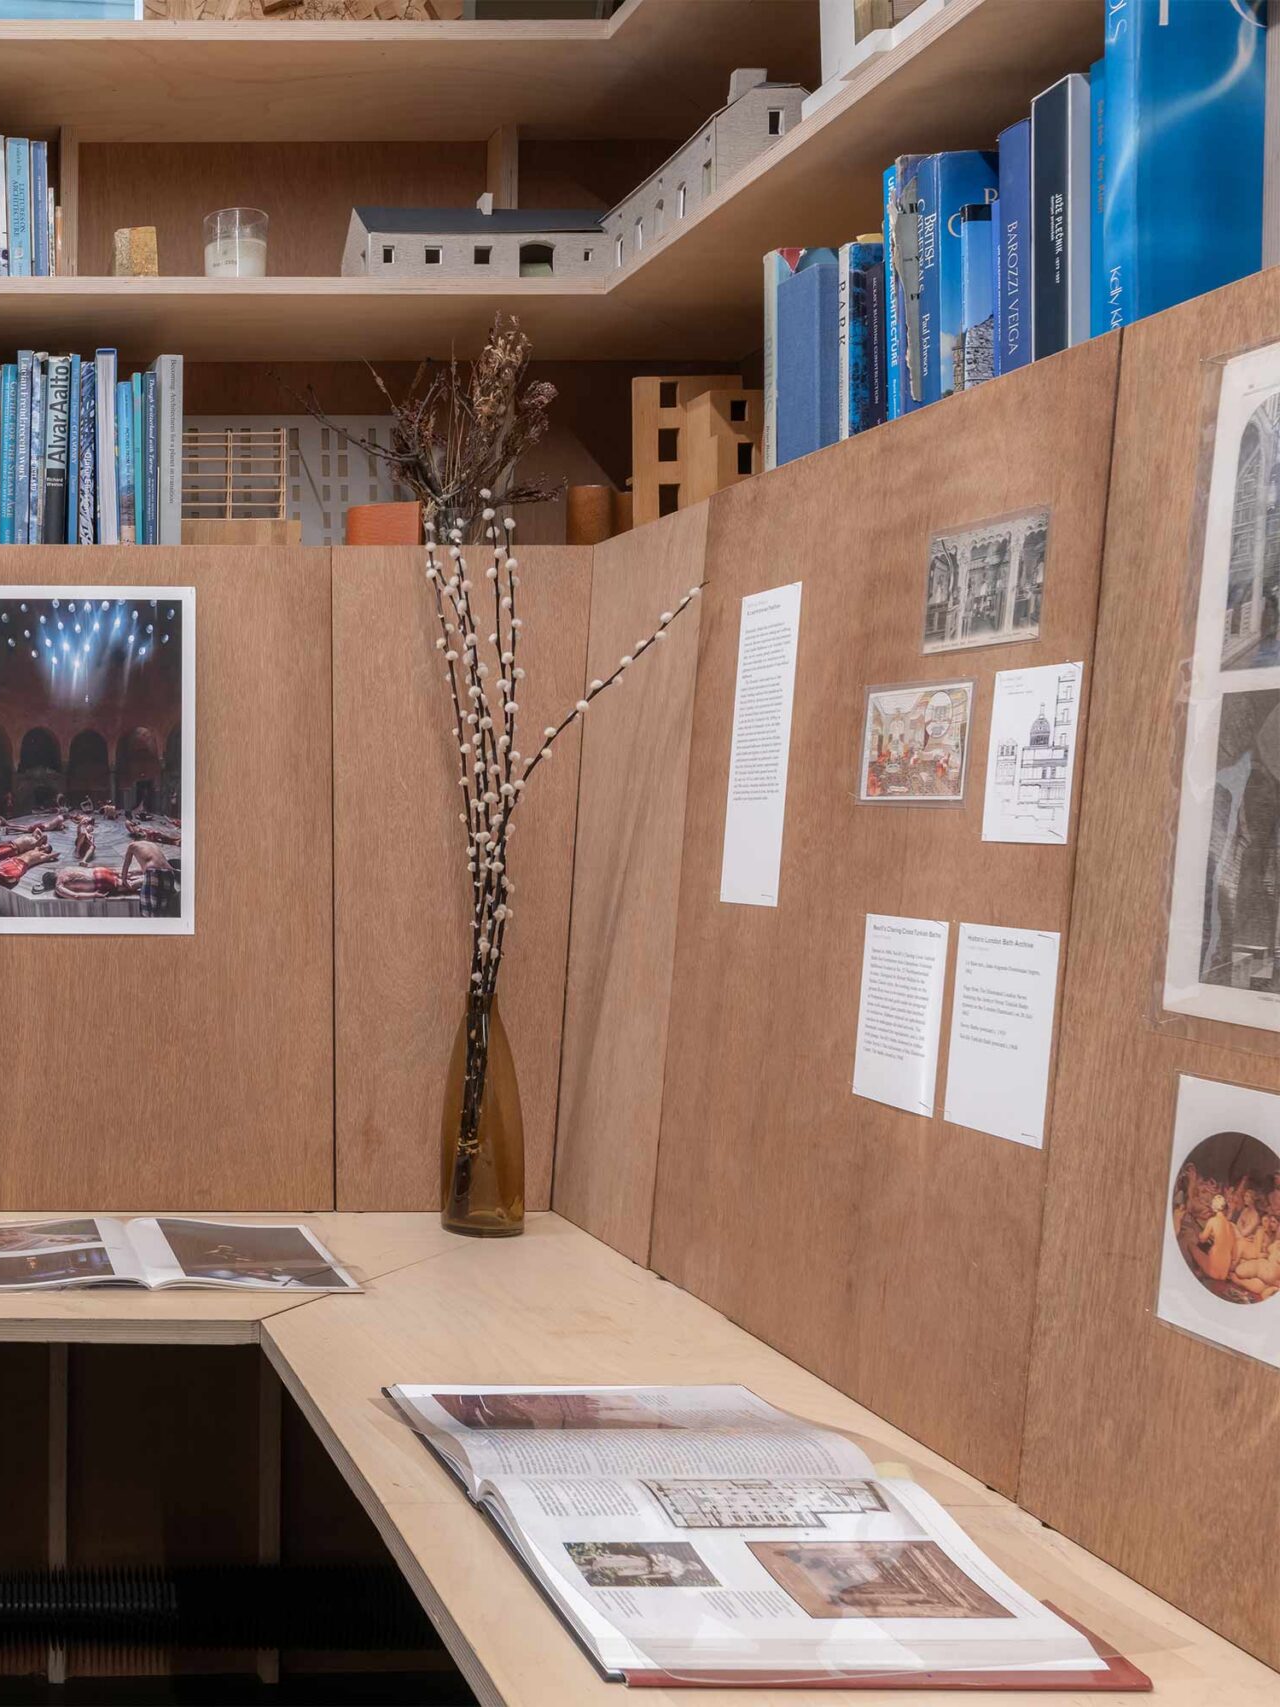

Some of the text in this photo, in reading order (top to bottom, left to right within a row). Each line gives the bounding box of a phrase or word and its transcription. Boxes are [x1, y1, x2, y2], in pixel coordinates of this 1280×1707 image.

[924, 212, 937, 268] BRITISH
[1055, 193, 1064, 255] JOŽE PLEČNIK
[1007, 221, 1019, 356] BAROZZI VEIGA
[1108, 266, 1123, 305] Kelly
[921, 313, 930, 377] Paul Johnson
[18, 357, 29, 393] Lucian
[147, 379, 155, 474] Through Switzerland with Turner
[169, 392, 177, 433] Architectures
[7, 381, 18, 518] GOTHIC FOR THE STEAM AGE
[18, 455, 28, 481] work
[168, 448, 176, 467] planet
[168, 475, 176, 504] transition
